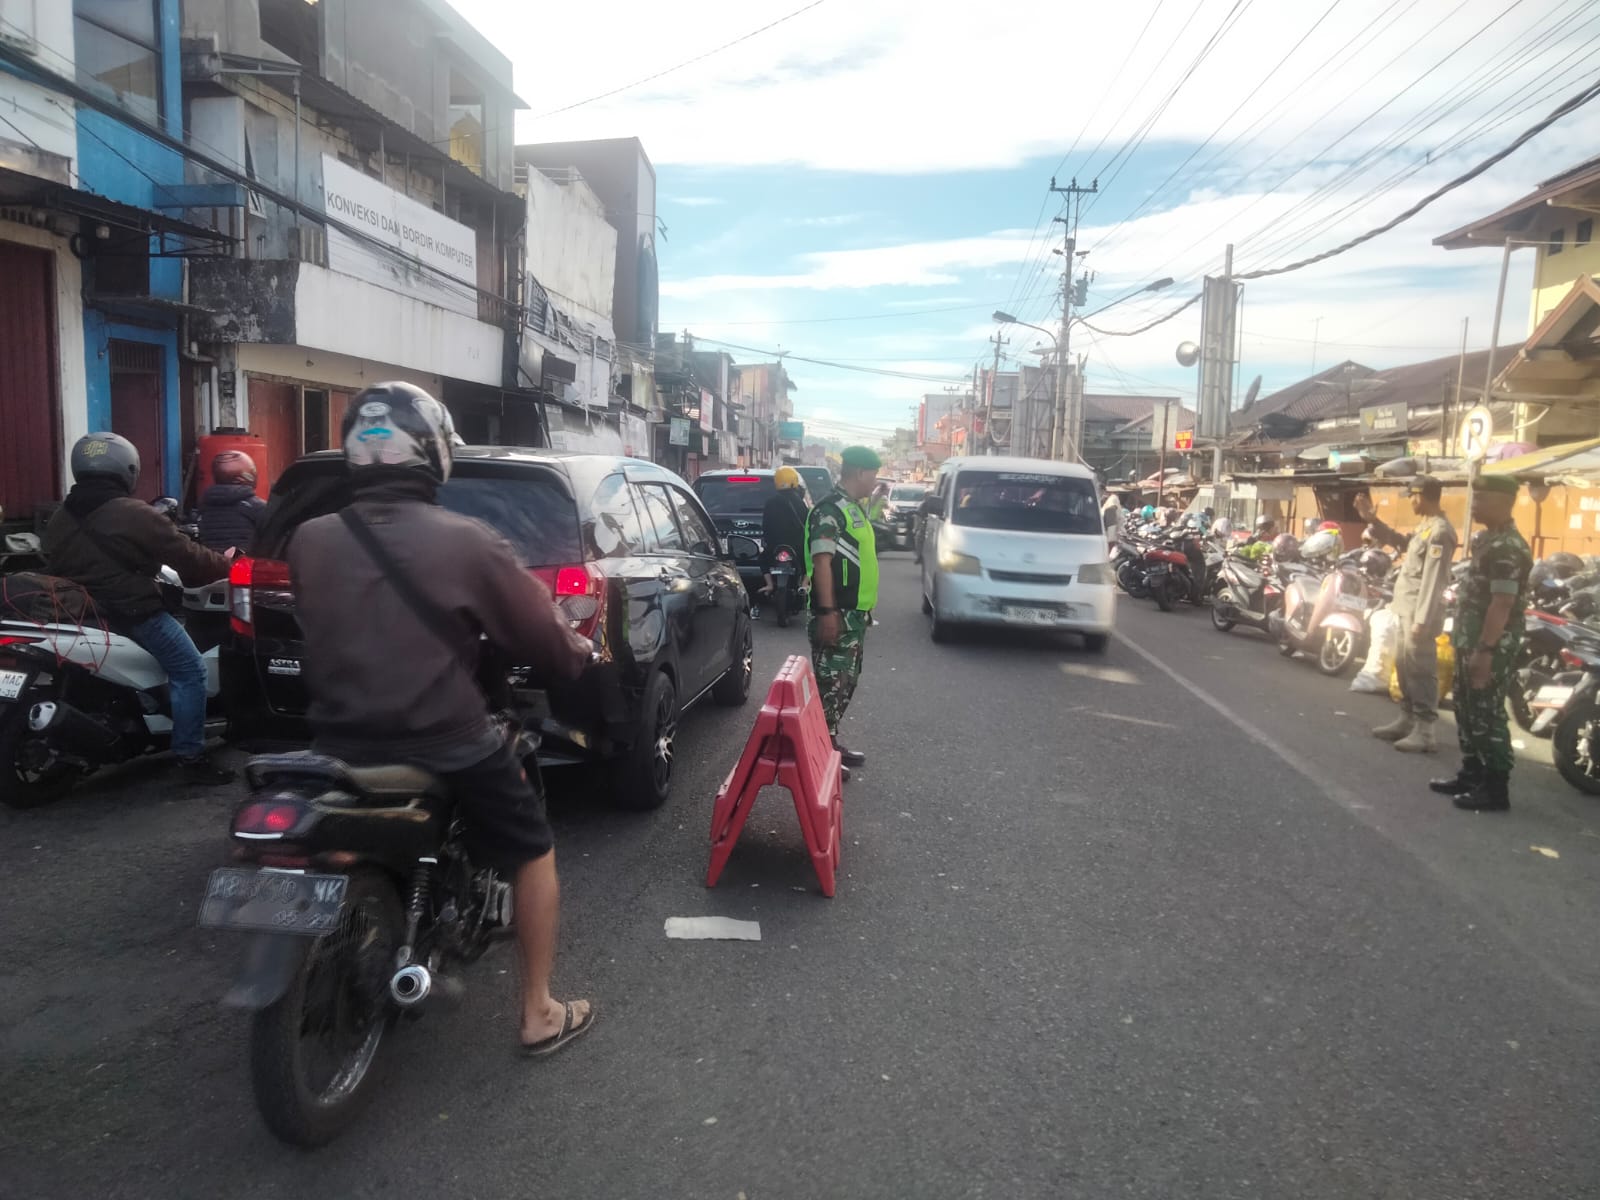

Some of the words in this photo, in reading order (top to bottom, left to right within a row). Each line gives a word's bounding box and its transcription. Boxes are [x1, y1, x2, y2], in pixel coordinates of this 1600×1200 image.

[327, 192, 379, 227] KONVEKSI
[381, 215, 400, 235] DAN
[402, 226, 434, 251] BORDIR
[435, 240, 473, 268] KOMPUTER
[1467, 418, 1485, 450] P
